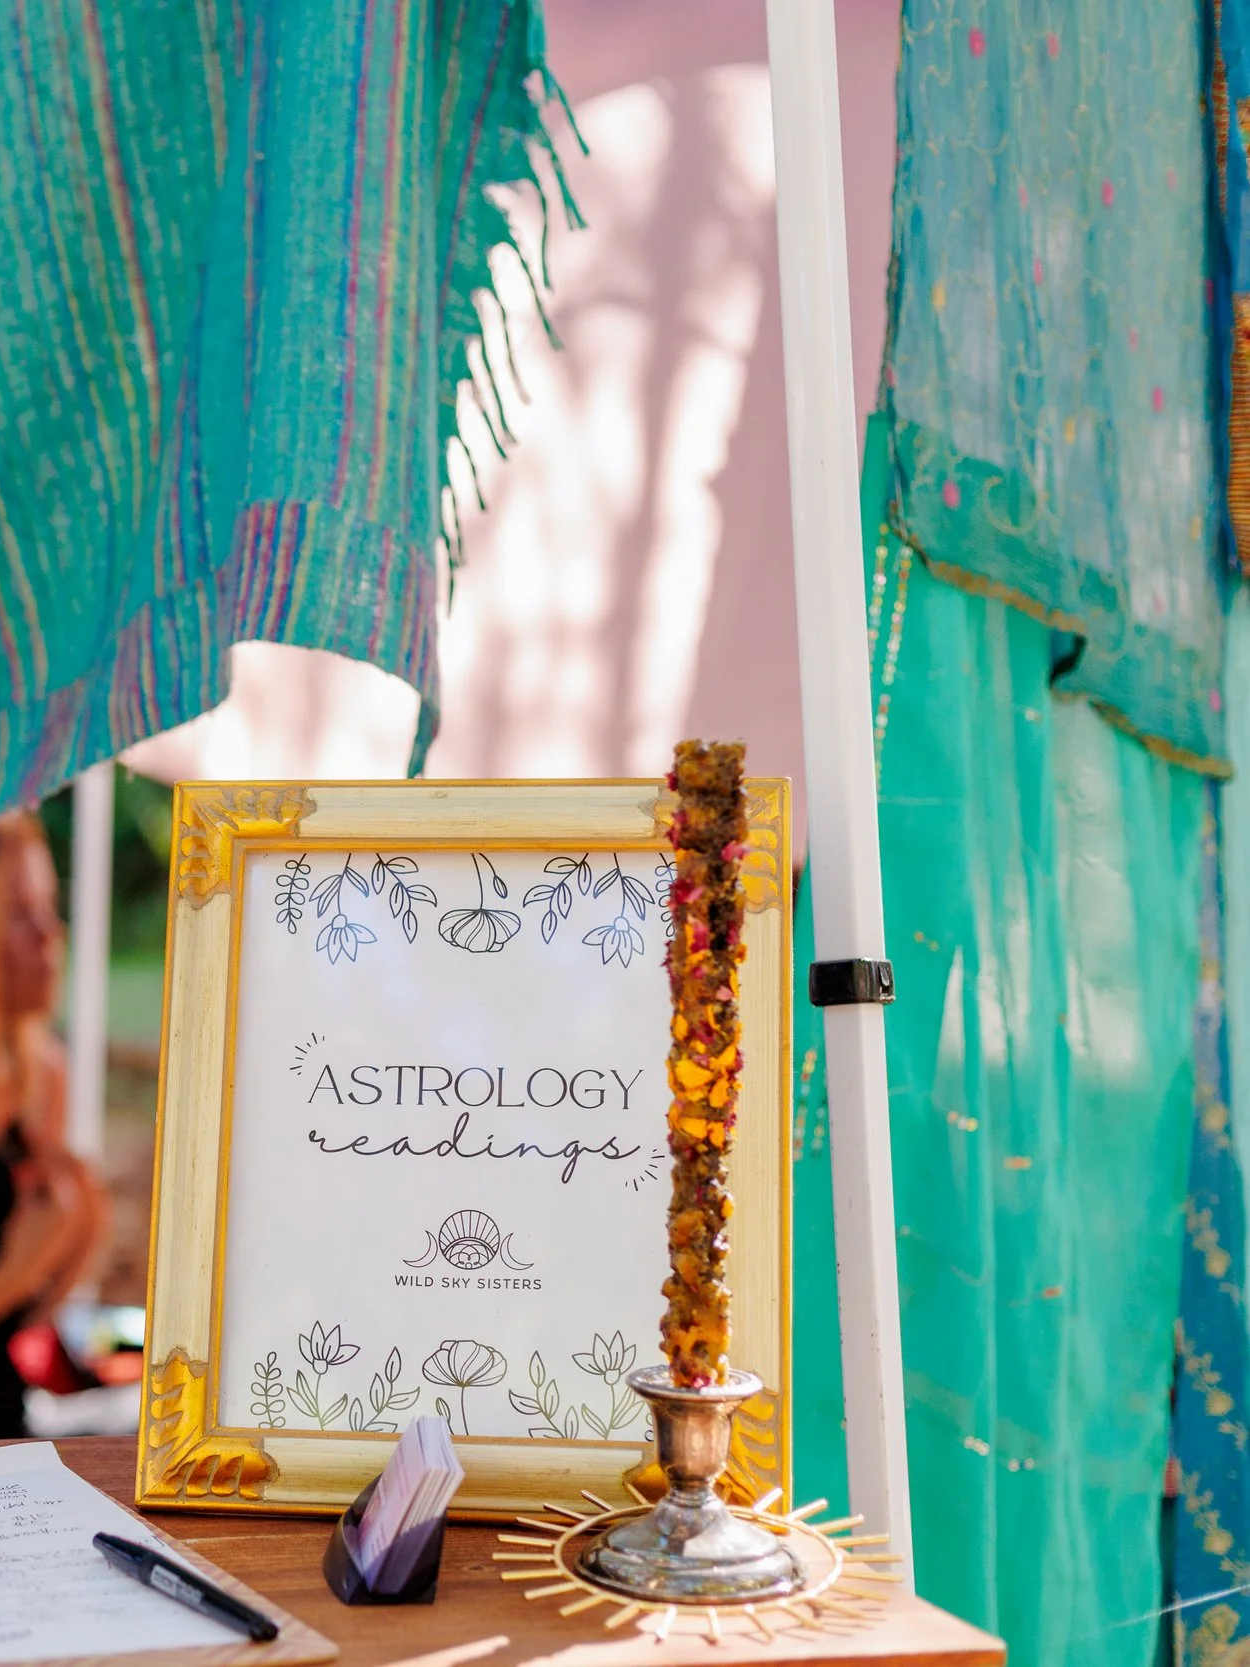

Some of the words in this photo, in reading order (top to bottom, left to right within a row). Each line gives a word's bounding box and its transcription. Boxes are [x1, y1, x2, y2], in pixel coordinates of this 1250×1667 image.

[307, 1063, 644, 1110] ASTROLOGY
[308, 1111, 641, 1184] readings
[394, 1274, 434, 1288] WILD
[441, 1276, 471, 1290] SKY
[477, 1277, 543, 1291] SISTERS
